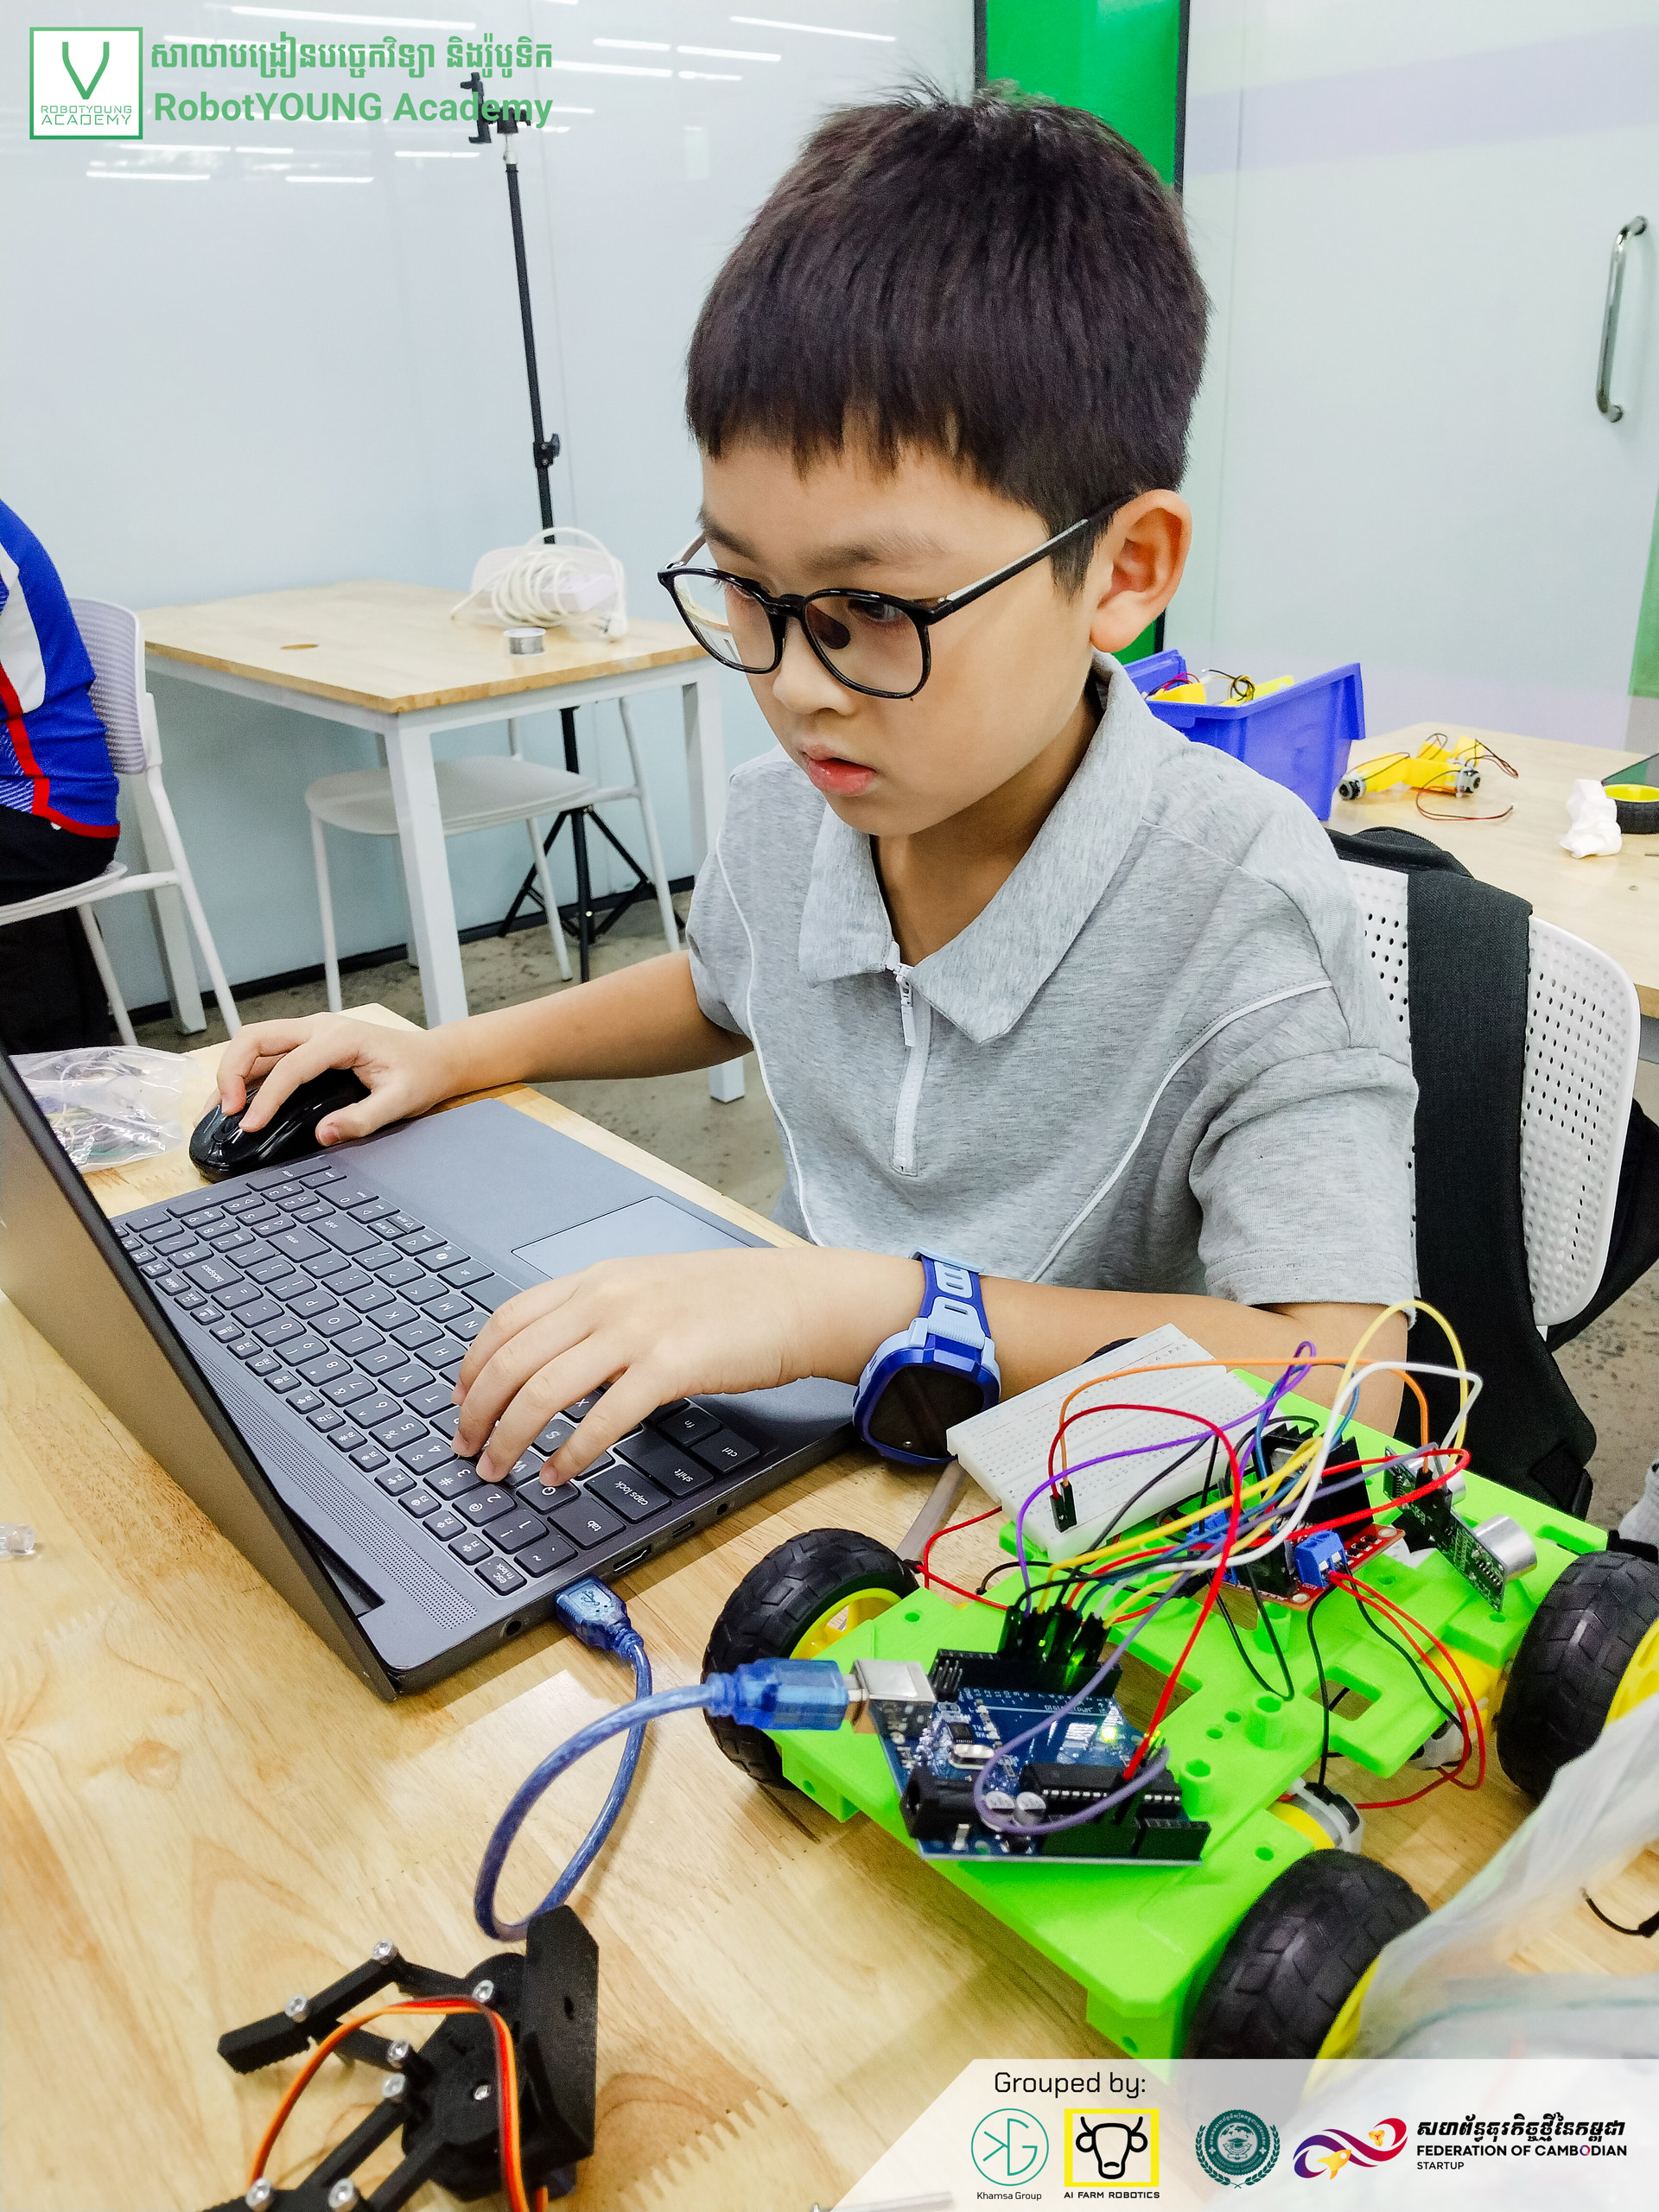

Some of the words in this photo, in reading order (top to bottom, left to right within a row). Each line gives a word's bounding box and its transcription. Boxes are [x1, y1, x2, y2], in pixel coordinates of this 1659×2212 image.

[201, 1265, 224, 1282] backspace
[575, 1397, 589, 1407] X
[722, 1447, 737, 1456] ctrl
[675, 1469, 693, 1482] shift
[615, 1481, 630, 1494] lock
[487, 1494, 501, 1503] 2
[630, 1491, 648, 1505] caps
[588, 1521, 601, 1531] tab
[497, 1562, 508, 1573] lock
[493, 1572, 507, 1583] esc
[505, 1570, 515, 1580] fn
